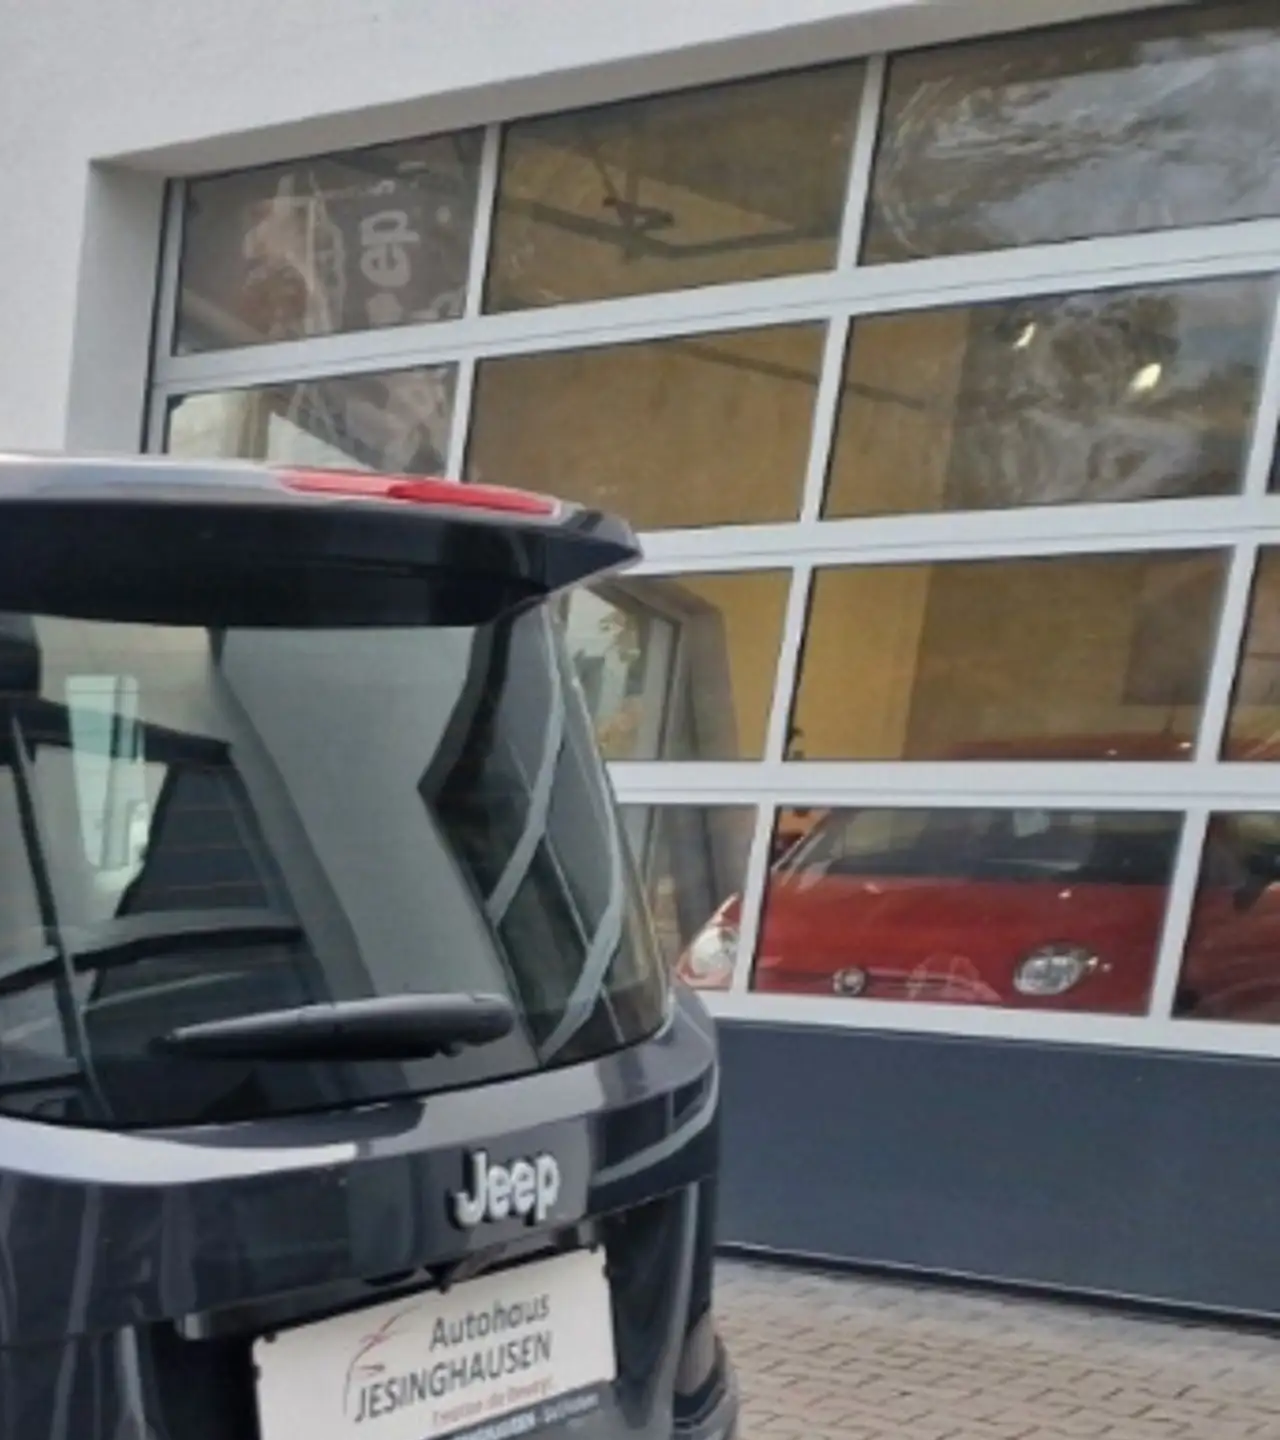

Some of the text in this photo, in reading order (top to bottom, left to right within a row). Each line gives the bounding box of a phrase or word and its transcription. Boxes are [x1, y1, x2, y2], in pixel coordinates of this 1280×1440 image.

[455, 1150, 560, 1224] Jeep
[428, 1294, 551, 1353] Autohaus
[353, 1330, 553, 1424] JESINGHAUSEN
